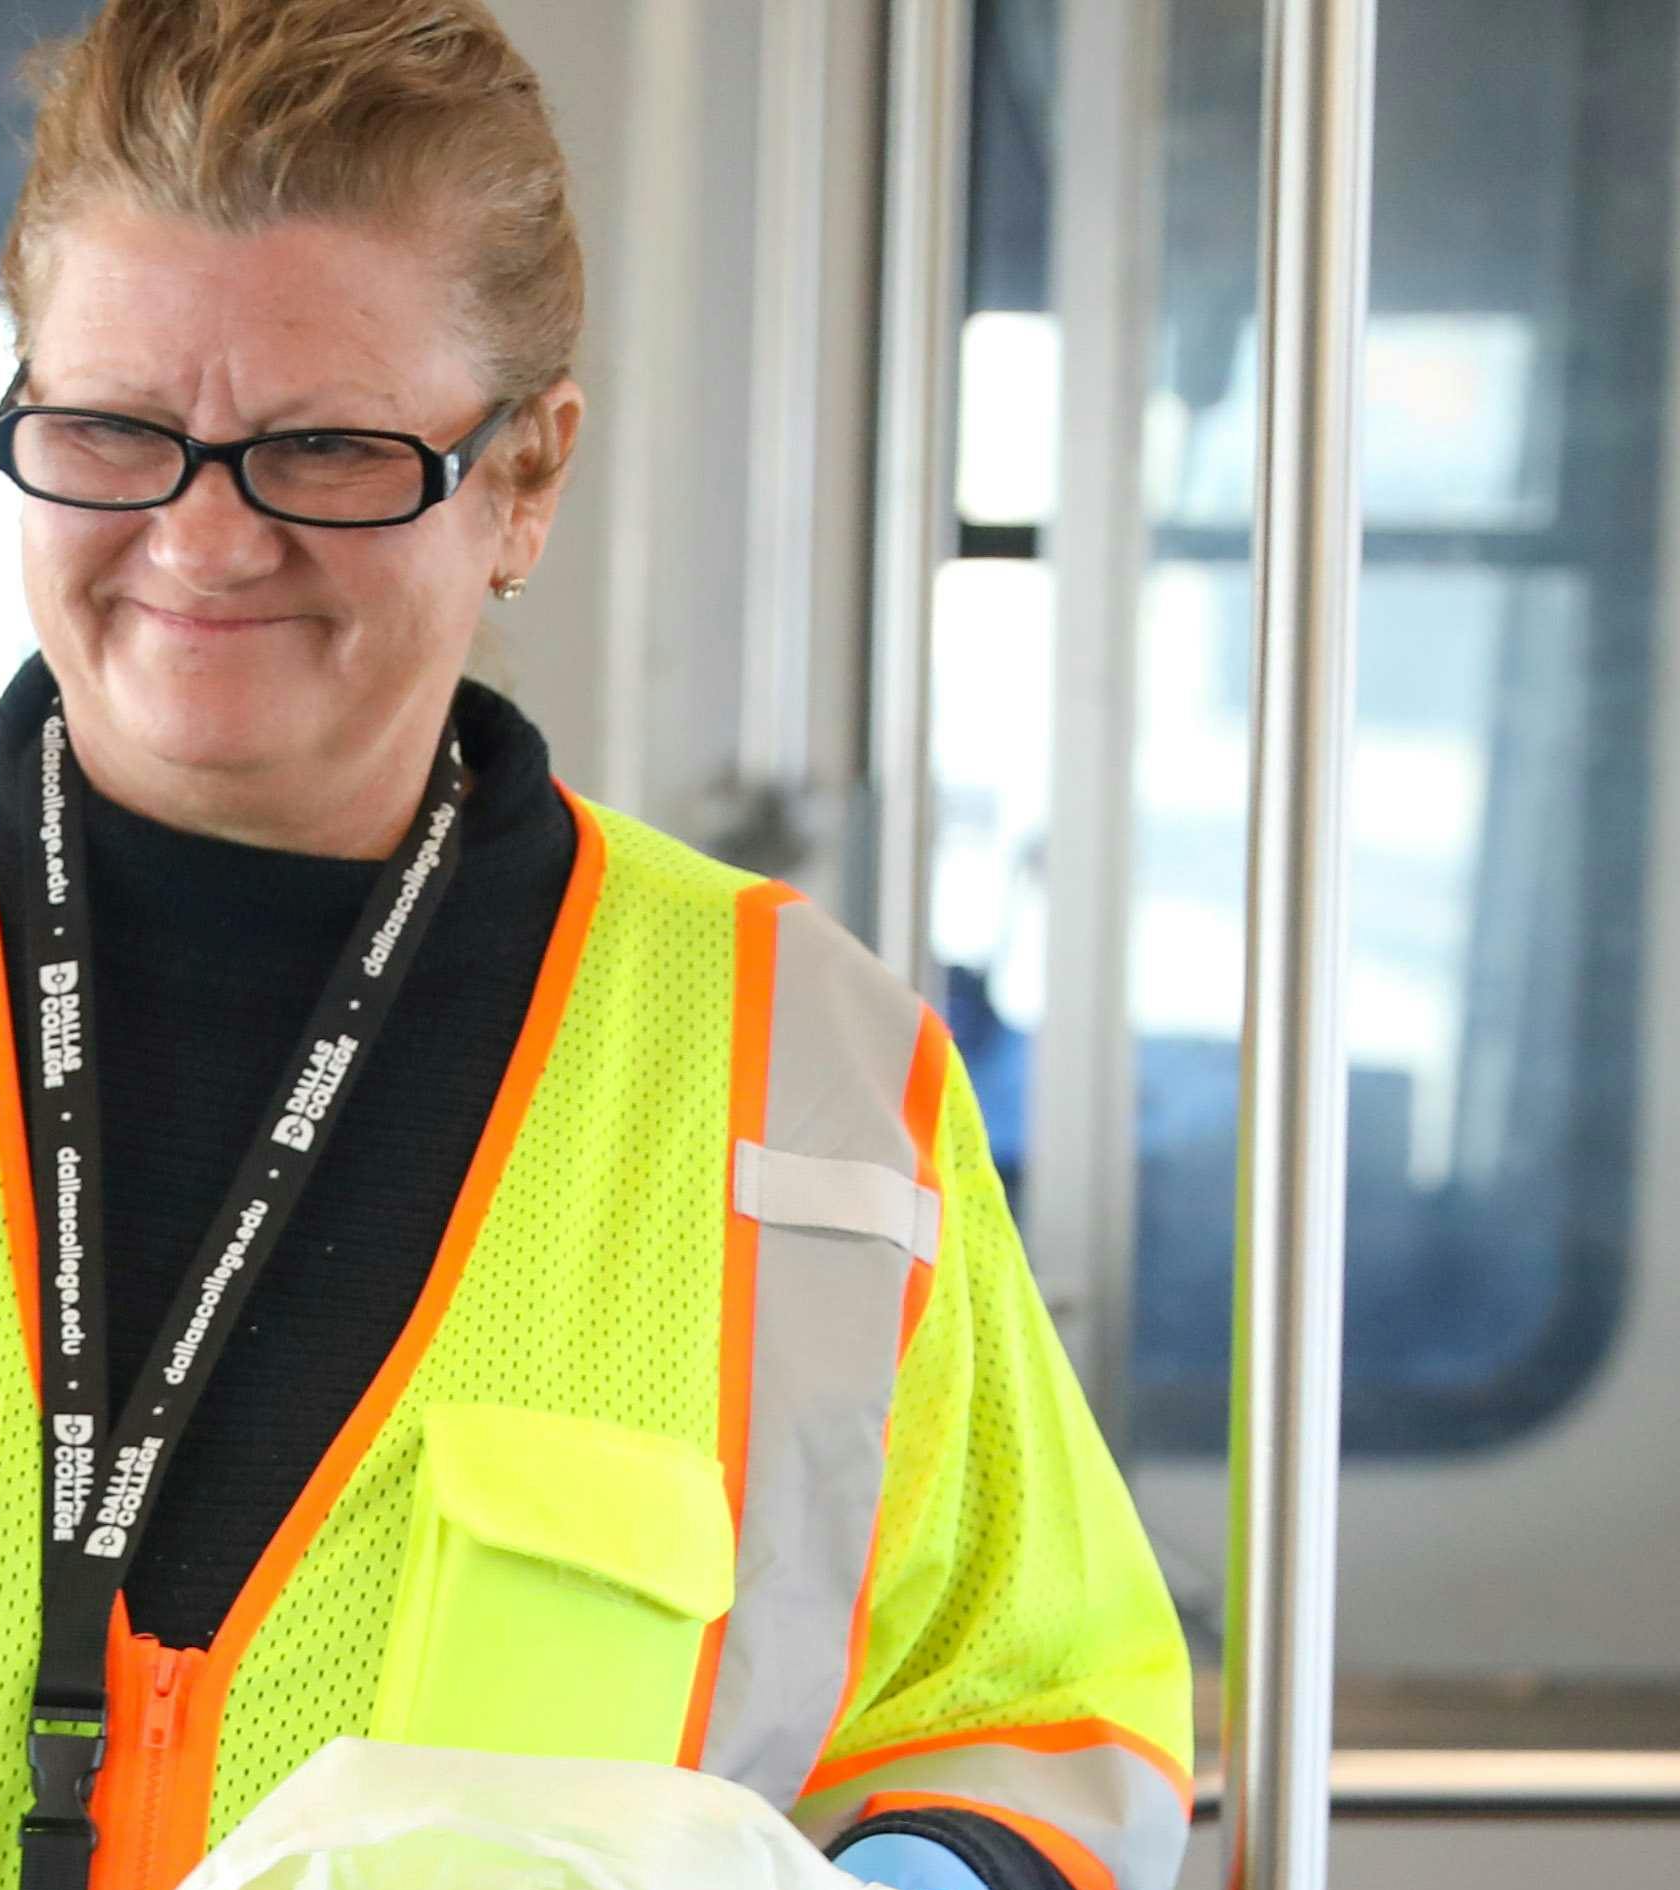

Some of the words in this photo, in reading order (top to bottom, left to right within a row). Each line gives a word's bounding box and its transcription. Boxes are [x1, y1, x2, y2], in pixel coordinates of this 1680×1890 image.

[40, 716, 70, 905] dallascollege.edu
[361, 803, 456, 977] dallascollege.edu
[40, 996, 64, 1089] COLLEGE
[60, 993, 82, 1073] DALLAS
[285, 1039, 335, 1114] DALLAS
[304, 1034, 359, 1121] COLLEGE
[55, 1147, 85, 1355] dallascollege.edu
[163, 1199, 269, 1385] dallascollege.edu
[53, 1445, 75, 1541] COLLEGE
[96, 1446, 139, 1524] DALLAS
[116, 1436, 165, 1527] COLLEGE
